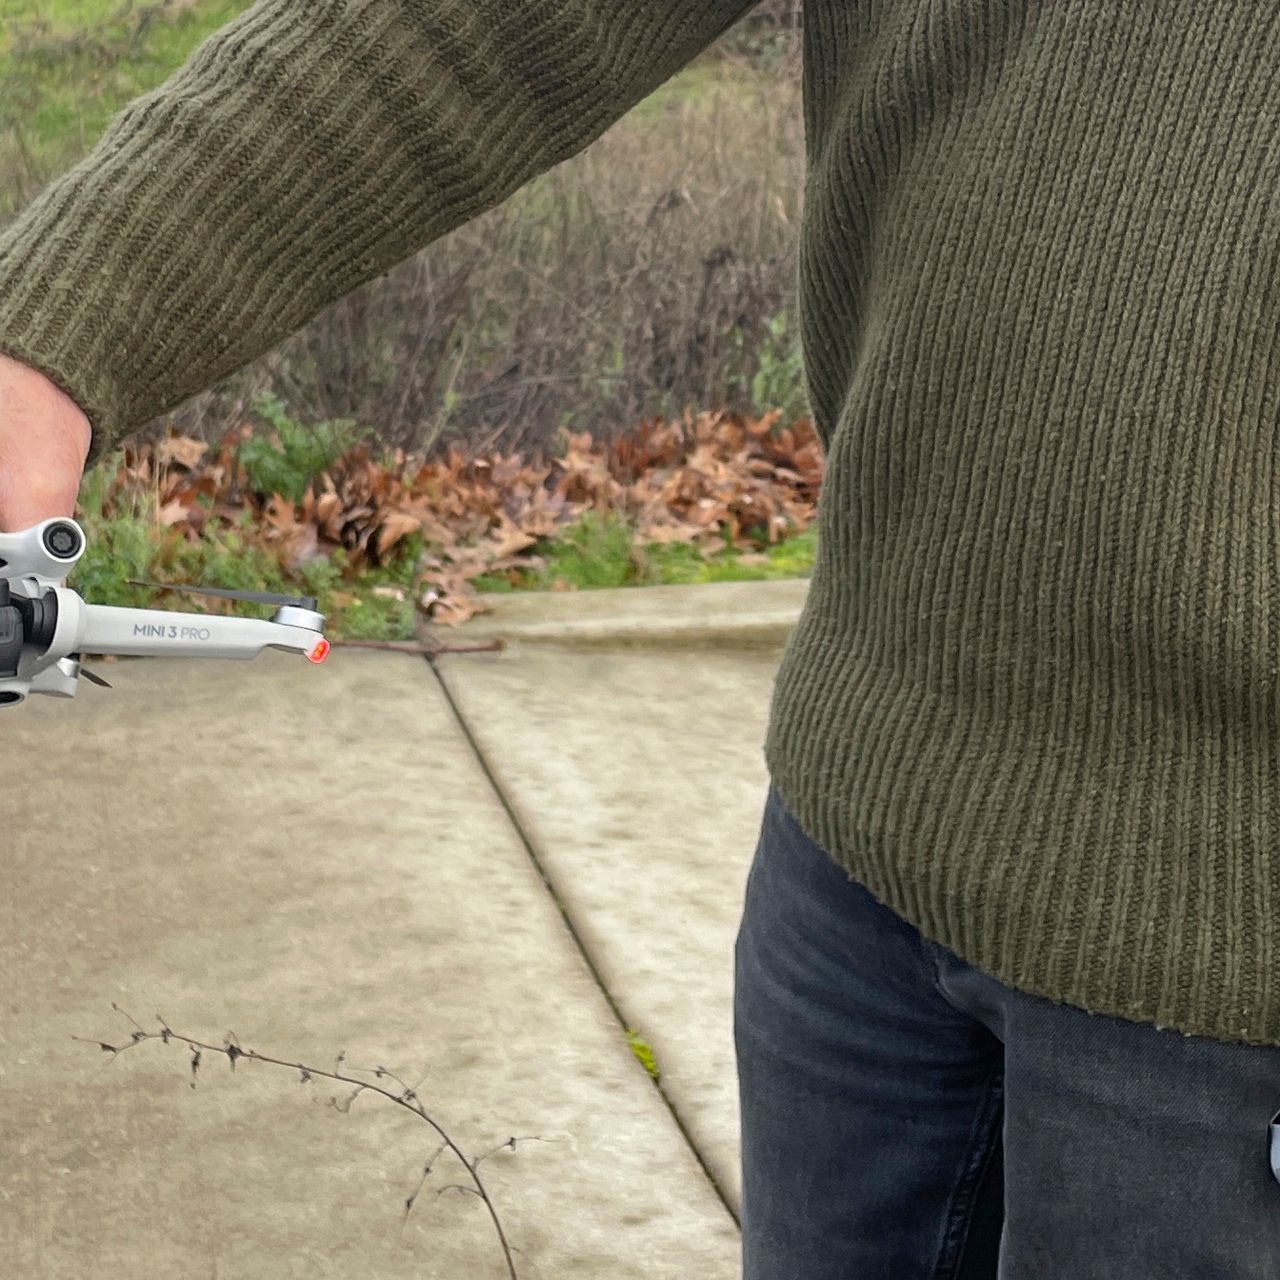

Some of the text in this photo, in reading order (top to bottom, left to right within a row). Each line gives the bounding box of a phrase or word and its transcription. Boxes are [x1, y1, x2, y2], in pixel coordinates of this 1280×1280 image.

[133, 624, 210, 640] MINI 3 PRO
